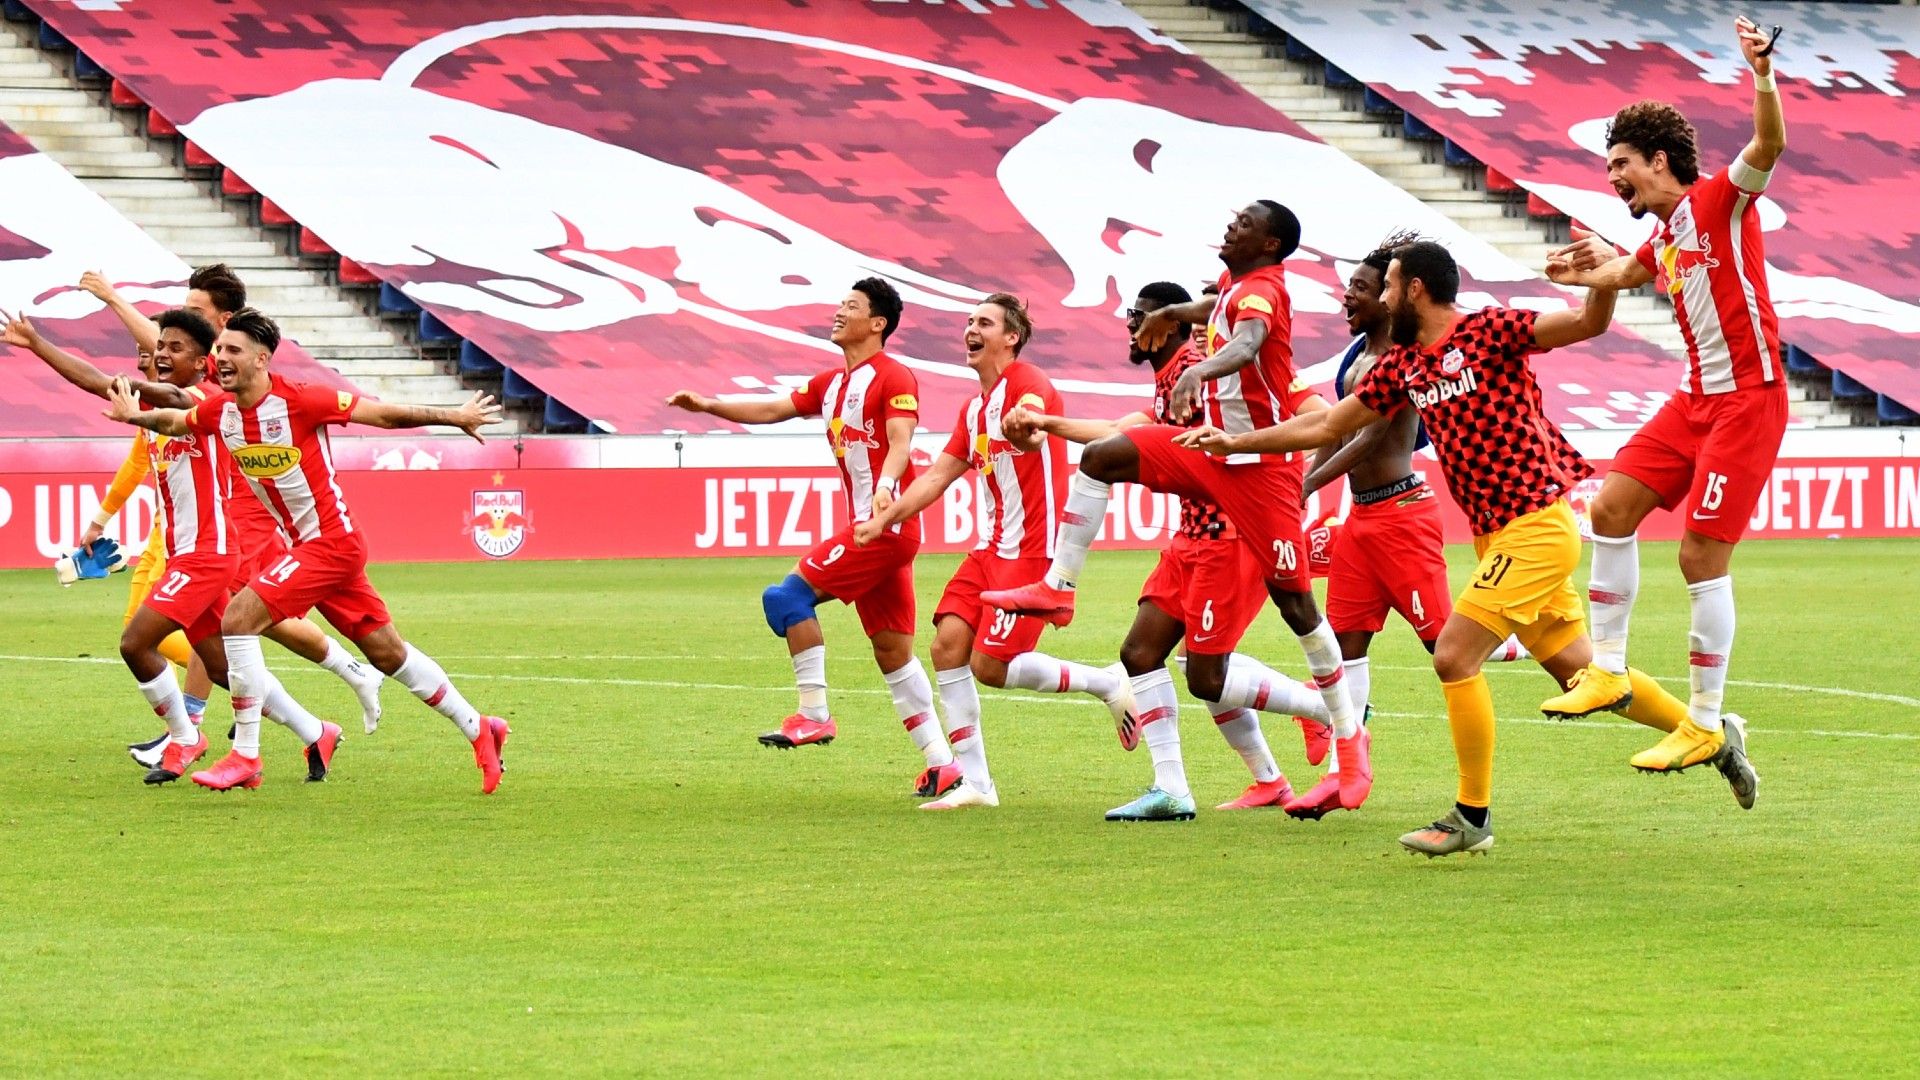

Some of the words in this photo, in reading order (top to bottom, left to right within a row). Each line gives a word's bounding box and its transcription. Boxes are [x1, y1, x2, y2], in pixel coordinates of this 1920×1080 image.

[1408, 382, 1439, 409] Red
[1437, 367, 1477, 400] Bull
[241, 451, 291, 469] RAUCH
[1360, 480, 1407, 503] COMBAT
[1701, 471, 1728, 511] 15
[1750, 466, 1869, 531] JETZT
[35, 484, 156, 559] UND
[695, 477, 842, 548] JETZT
[822, 544, 846, 566] 9
[1273, 539, 1297, 571] 20
[1310, 526, 1331, 564] Red
[161, 570, 191, 596] 27
[270, 555, 300, 583] 14
[1482, 553, 1513, 587] 31
[1201, 599, 1214, 632] 6
[1411, 590, 1425, 621] 4
